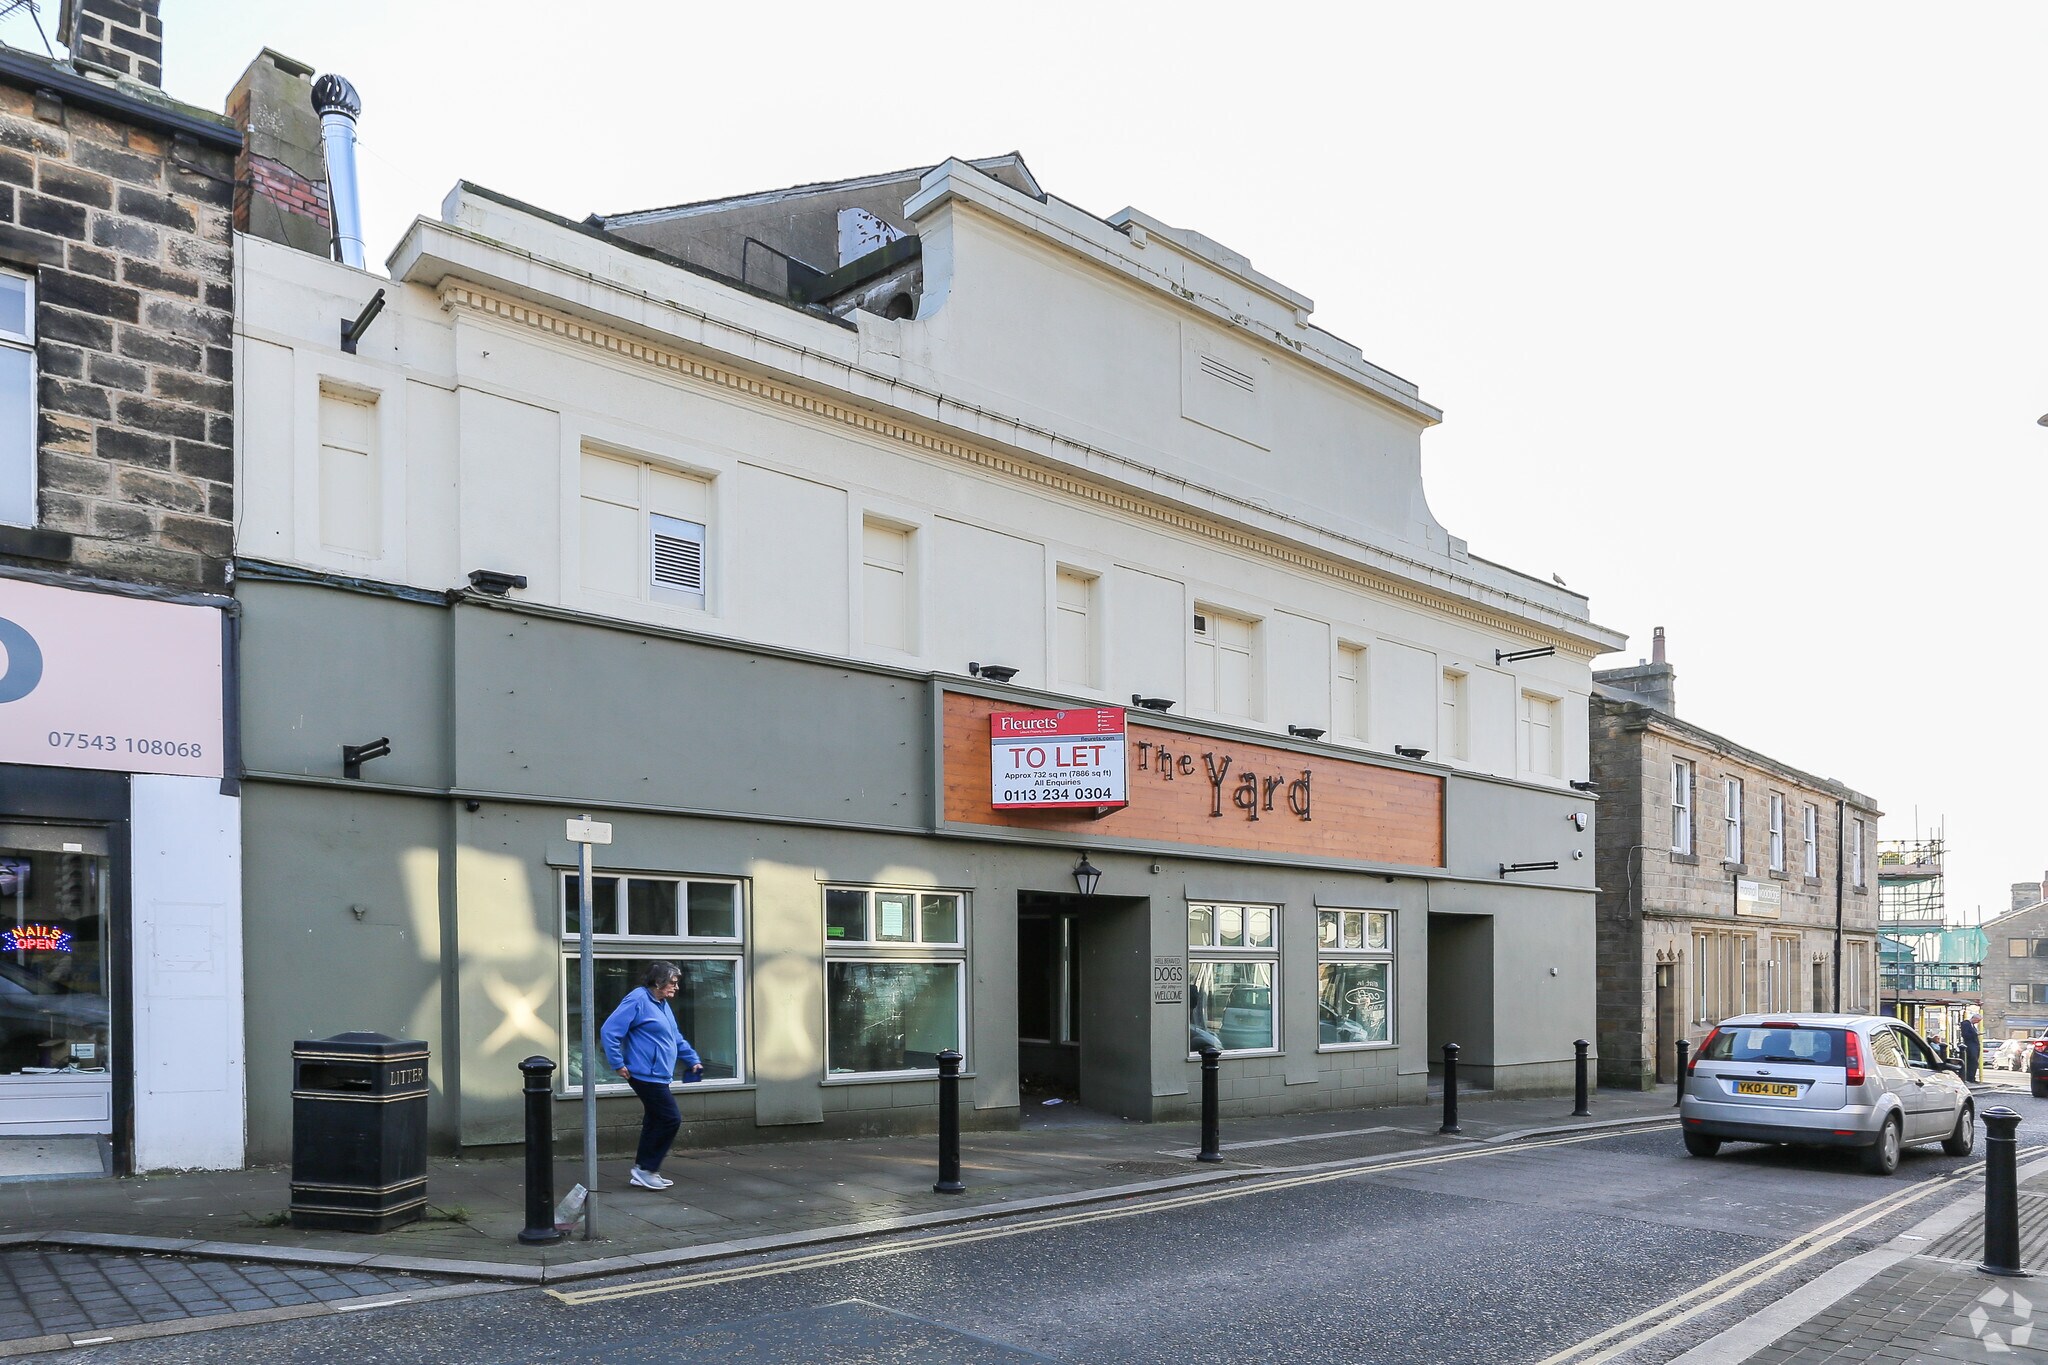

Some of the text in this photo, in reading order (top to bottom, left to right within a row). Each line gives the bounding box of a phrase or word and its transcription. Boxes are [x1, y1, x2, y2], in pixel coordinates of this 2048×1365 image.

[1001, 717, 1057, 730] Fleurets
[48, 732, 202, 758] 07543 108068
[1009, 745, 1106, 768] TO LET
[1004, 772, 1032, 780] Approx
[1069, 770, 1090, 778] (7886
[1137, 740, 1312, 822] The Yard
[1046, 779, 1081, 787] Enquiries
[1004, 787, 1112, 801] 0113 234 0304
[11, 925, 63, 940] NAILS
[16, 938, 57, 950] OPEN
[1154, 967, 1182, 981] DOGS
[1154, 991, 1182, 1000] WELCOME
[390, 1068, 423, 1086] LITTER
[1740, 1082, 1796, 1096] YK04 UCP
